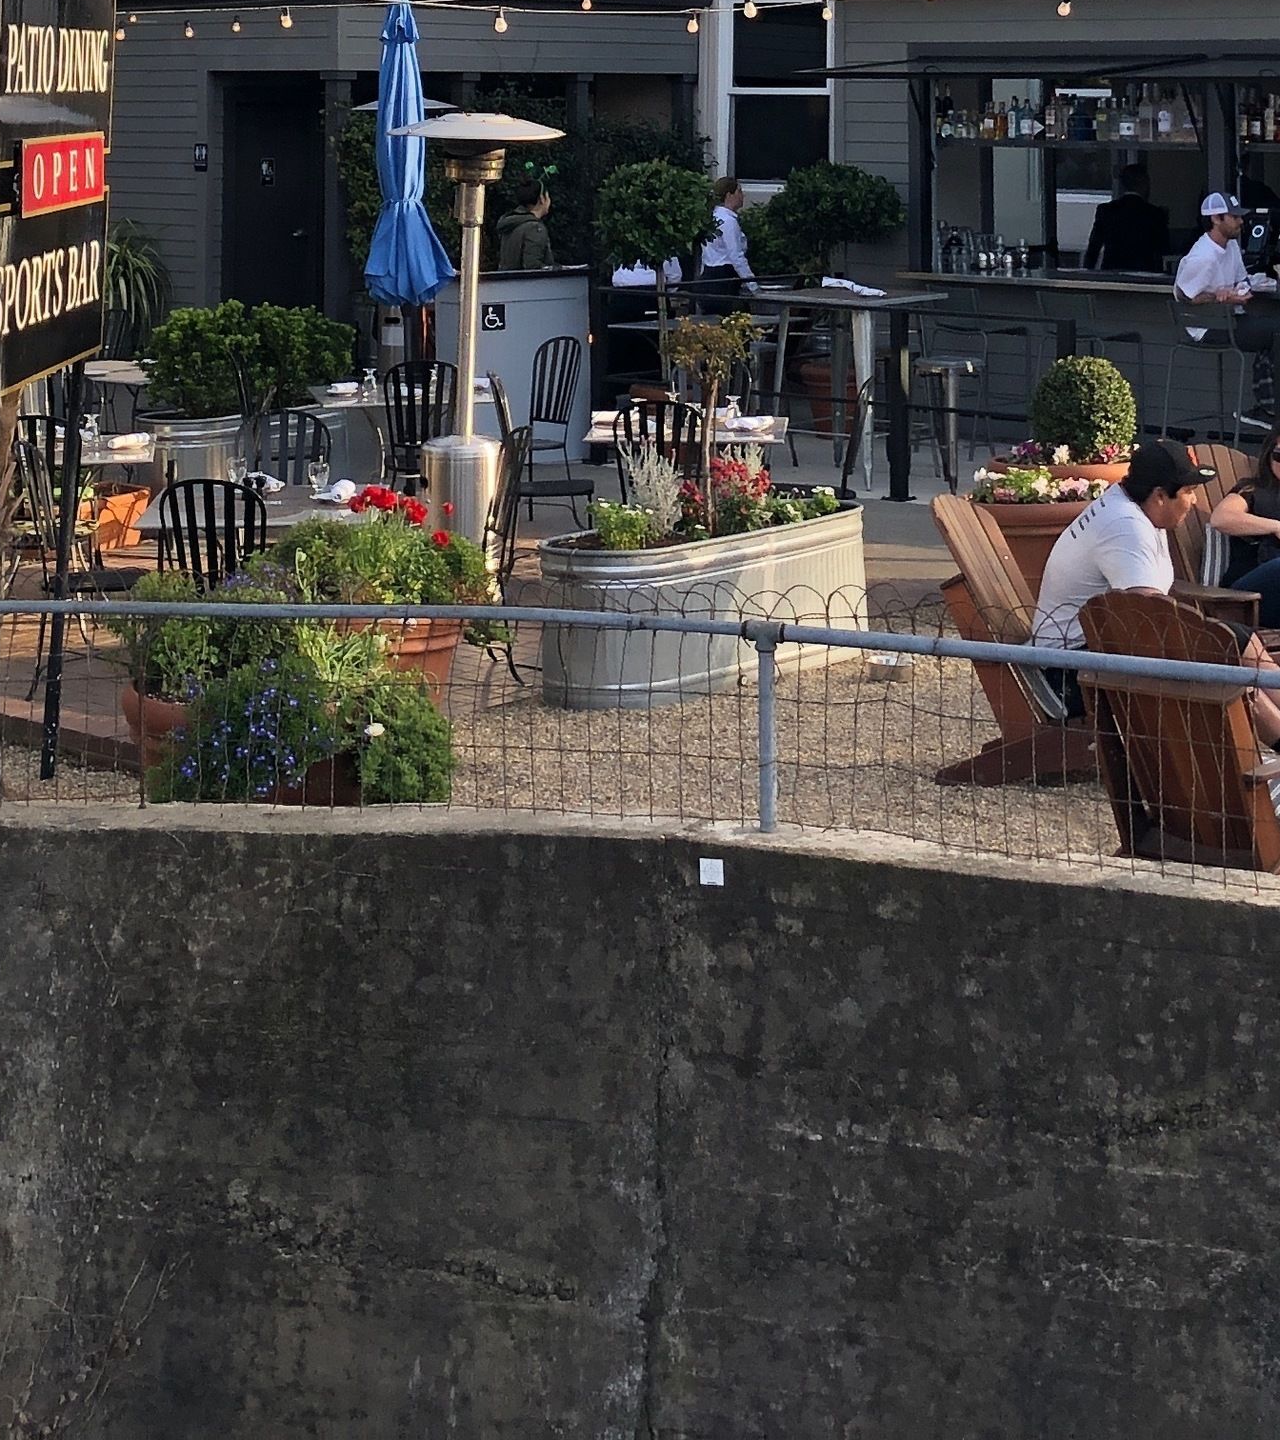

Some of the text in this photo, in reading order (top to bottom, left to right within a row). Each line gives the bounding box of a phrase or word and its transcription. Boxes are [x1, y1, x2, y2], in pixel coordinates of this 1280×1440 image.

[4, 23, 109, 94] PATIO DINING
[32, 147, 97, 200] OPEN
[66, 239, 100, 314] BAR
